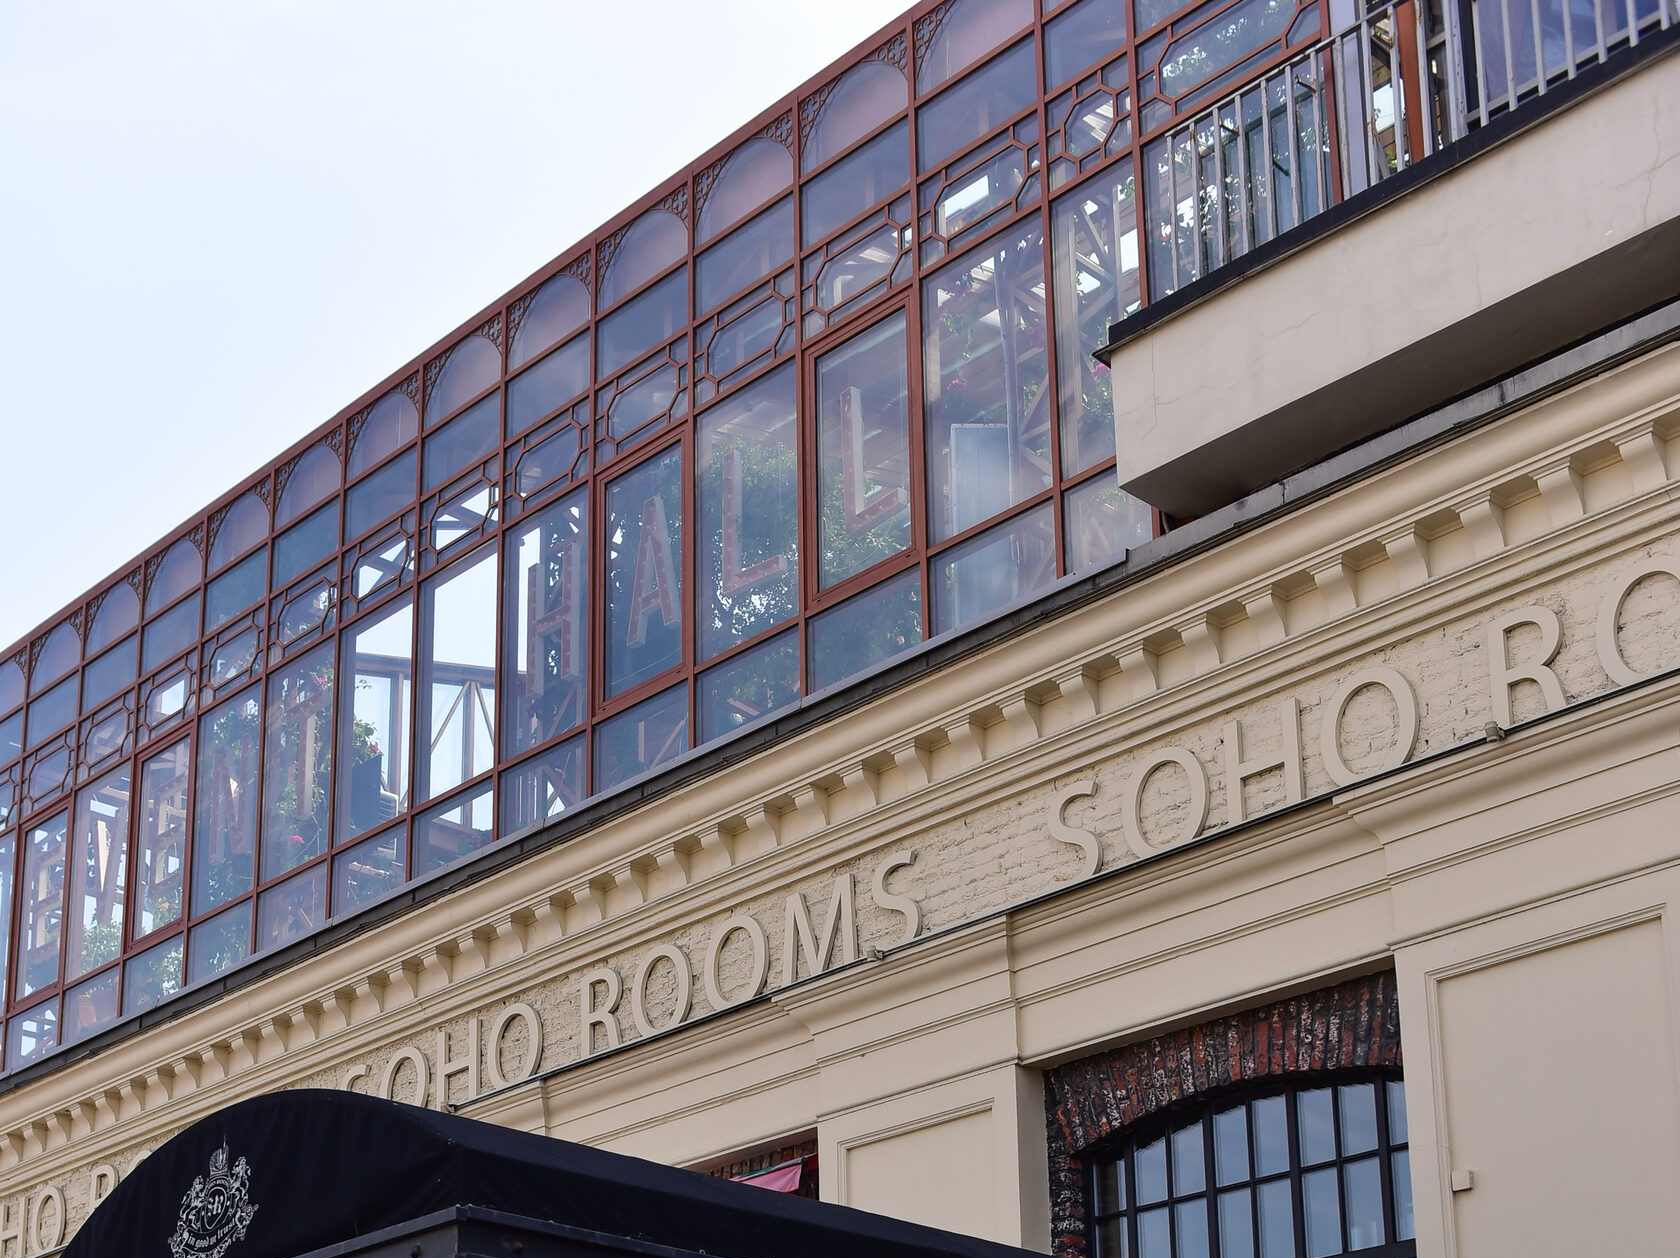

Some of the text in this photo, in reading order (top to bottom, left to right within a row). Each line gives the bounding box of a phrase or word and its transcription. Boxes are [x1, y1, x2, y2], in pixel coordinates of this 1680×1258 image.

[526, 386, 908, 697] HALL
[1048, 668, 1420, 883] SOHO
[580, 849, 923, 1056] ROOMS
